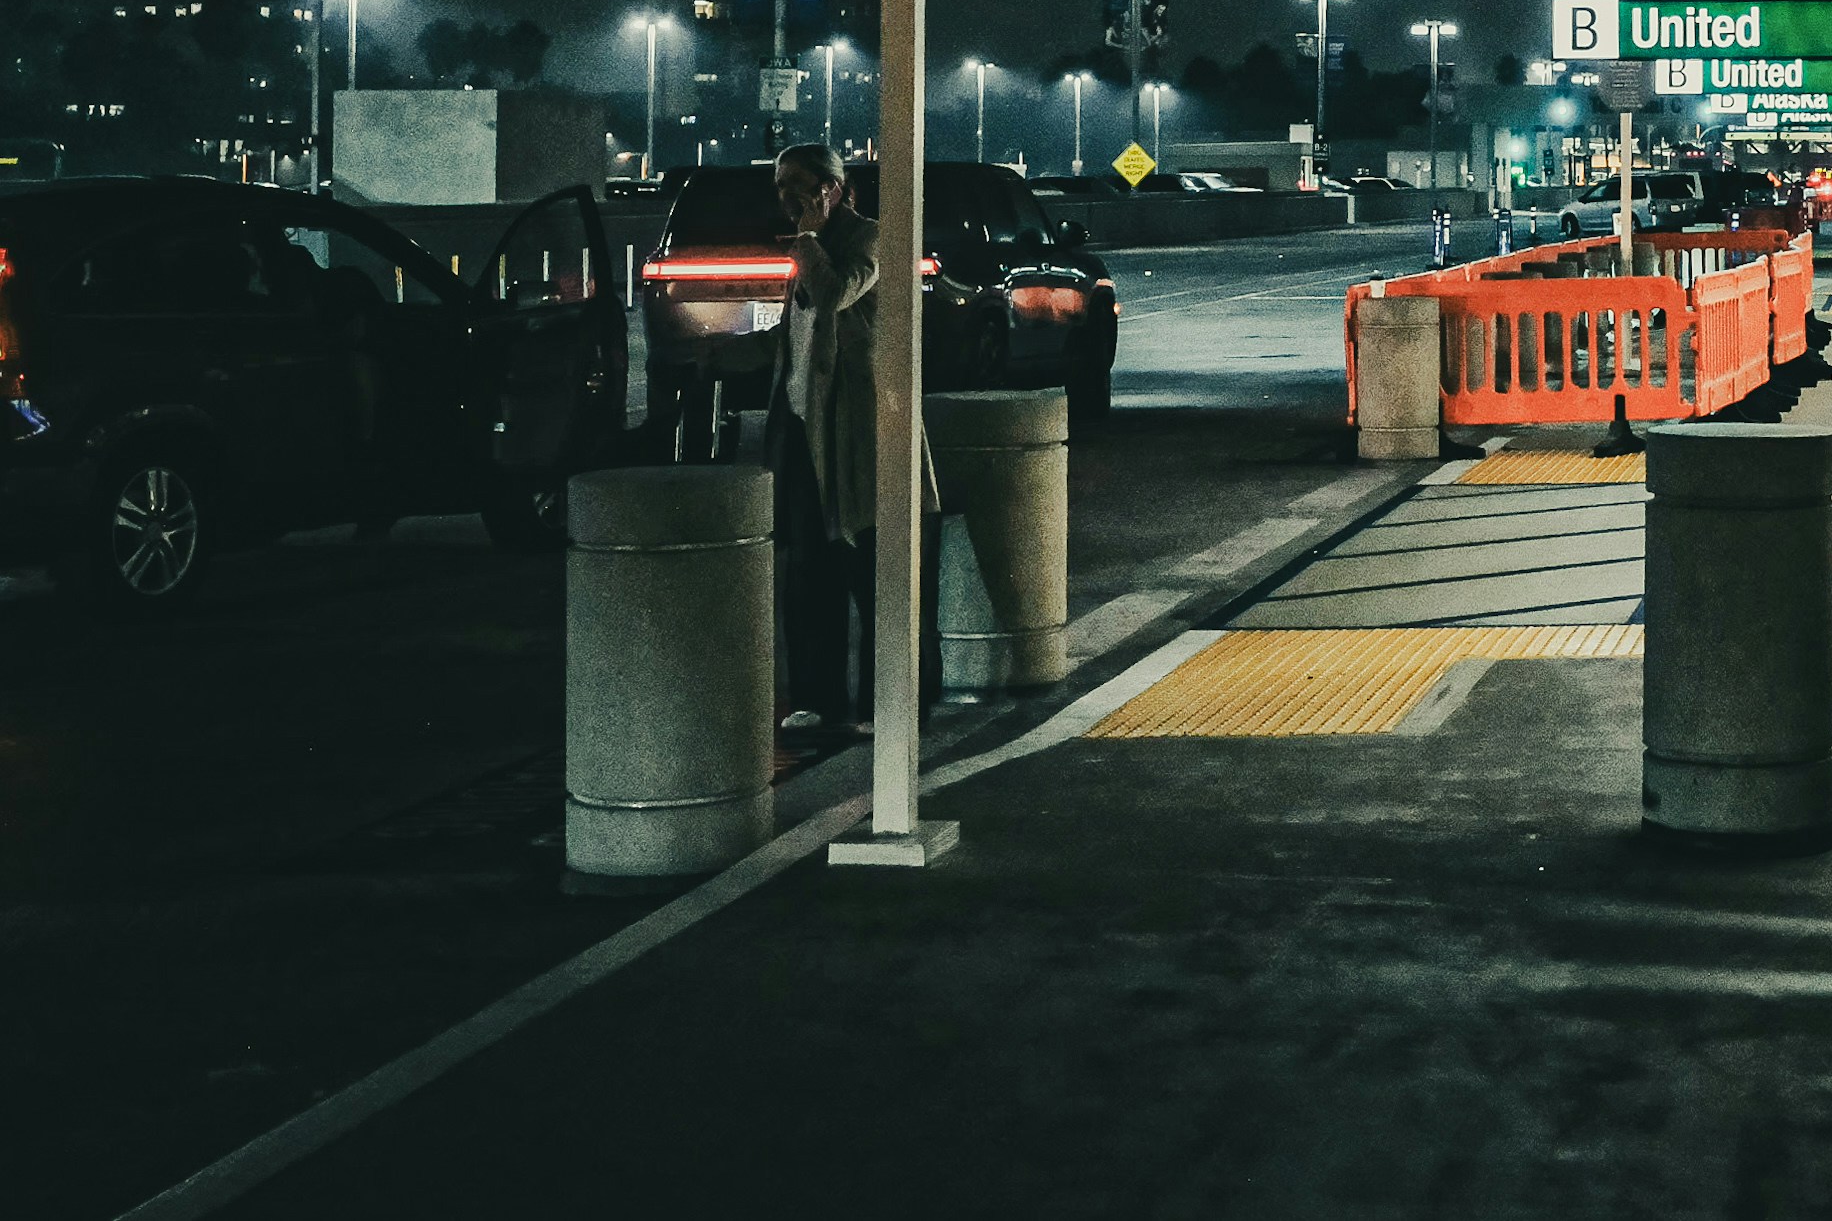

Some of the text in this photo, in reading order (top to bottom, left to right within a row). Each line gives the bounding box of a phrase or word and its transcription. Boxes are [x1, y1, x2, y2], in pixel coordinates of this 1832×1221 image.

[1571, 7, 1598, 50] B
[1631, 6, 1761, 48] United
[1669, 59, 1687, 88] B
[1710, 58, 1803, 88] United
